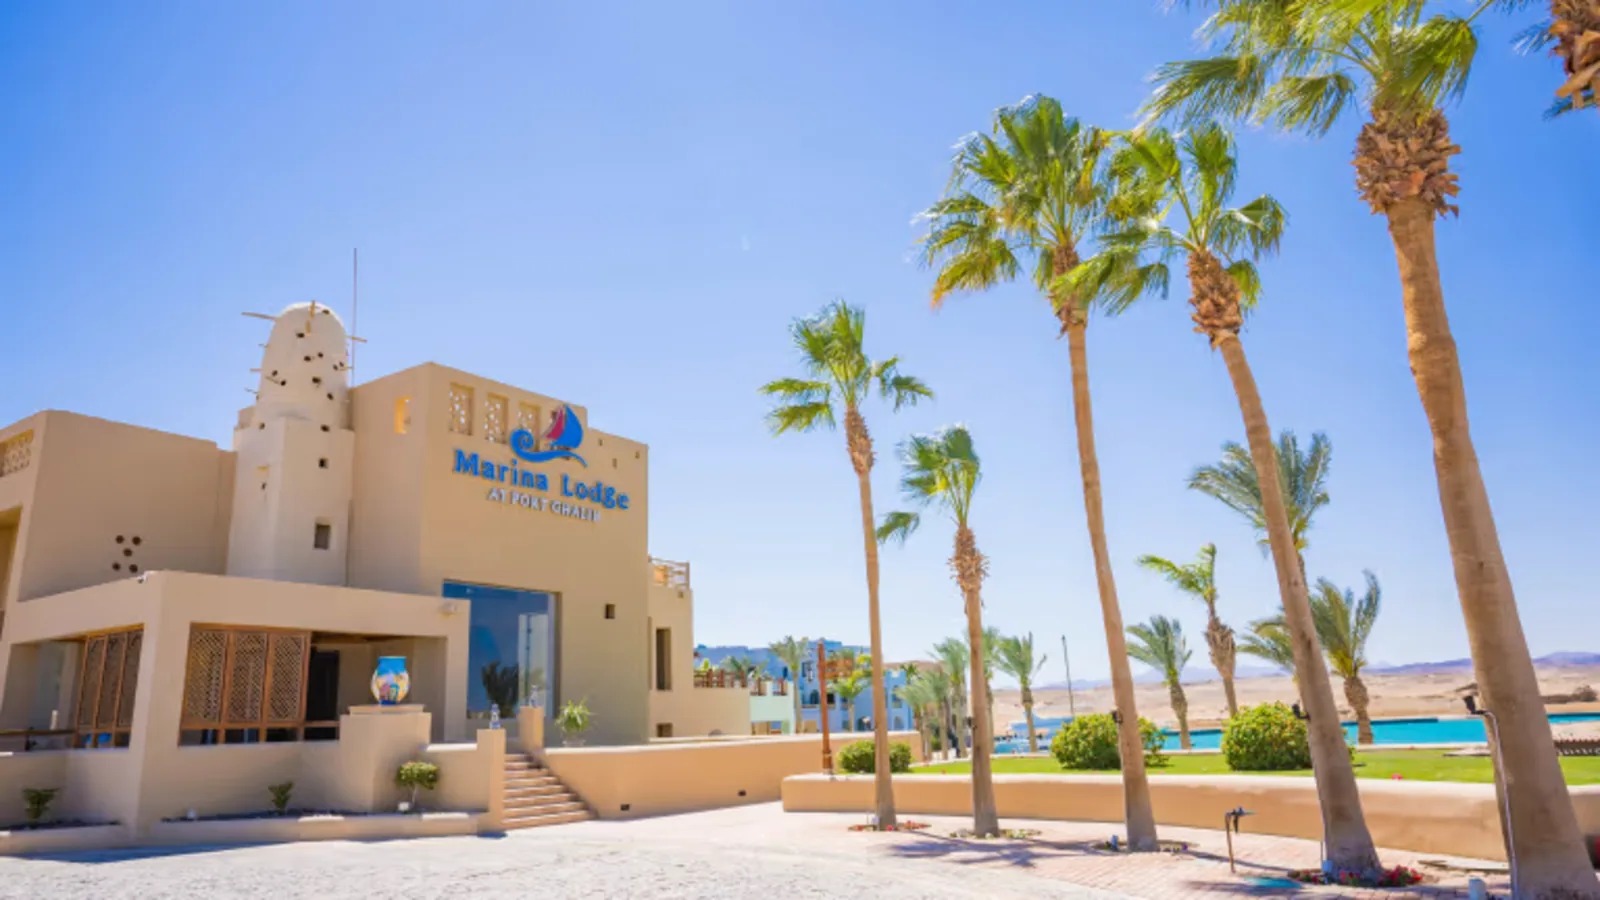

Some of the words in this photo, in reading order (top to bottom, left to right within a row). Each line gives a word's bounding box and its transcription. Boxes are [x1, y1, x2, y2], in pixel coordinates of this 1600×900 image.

[454, 449, 549, 491] Marina
[561, 472, 630, 509] Lodge
[488, 487, 507, 503] AT
[510, 491, 549, 511] PORT
